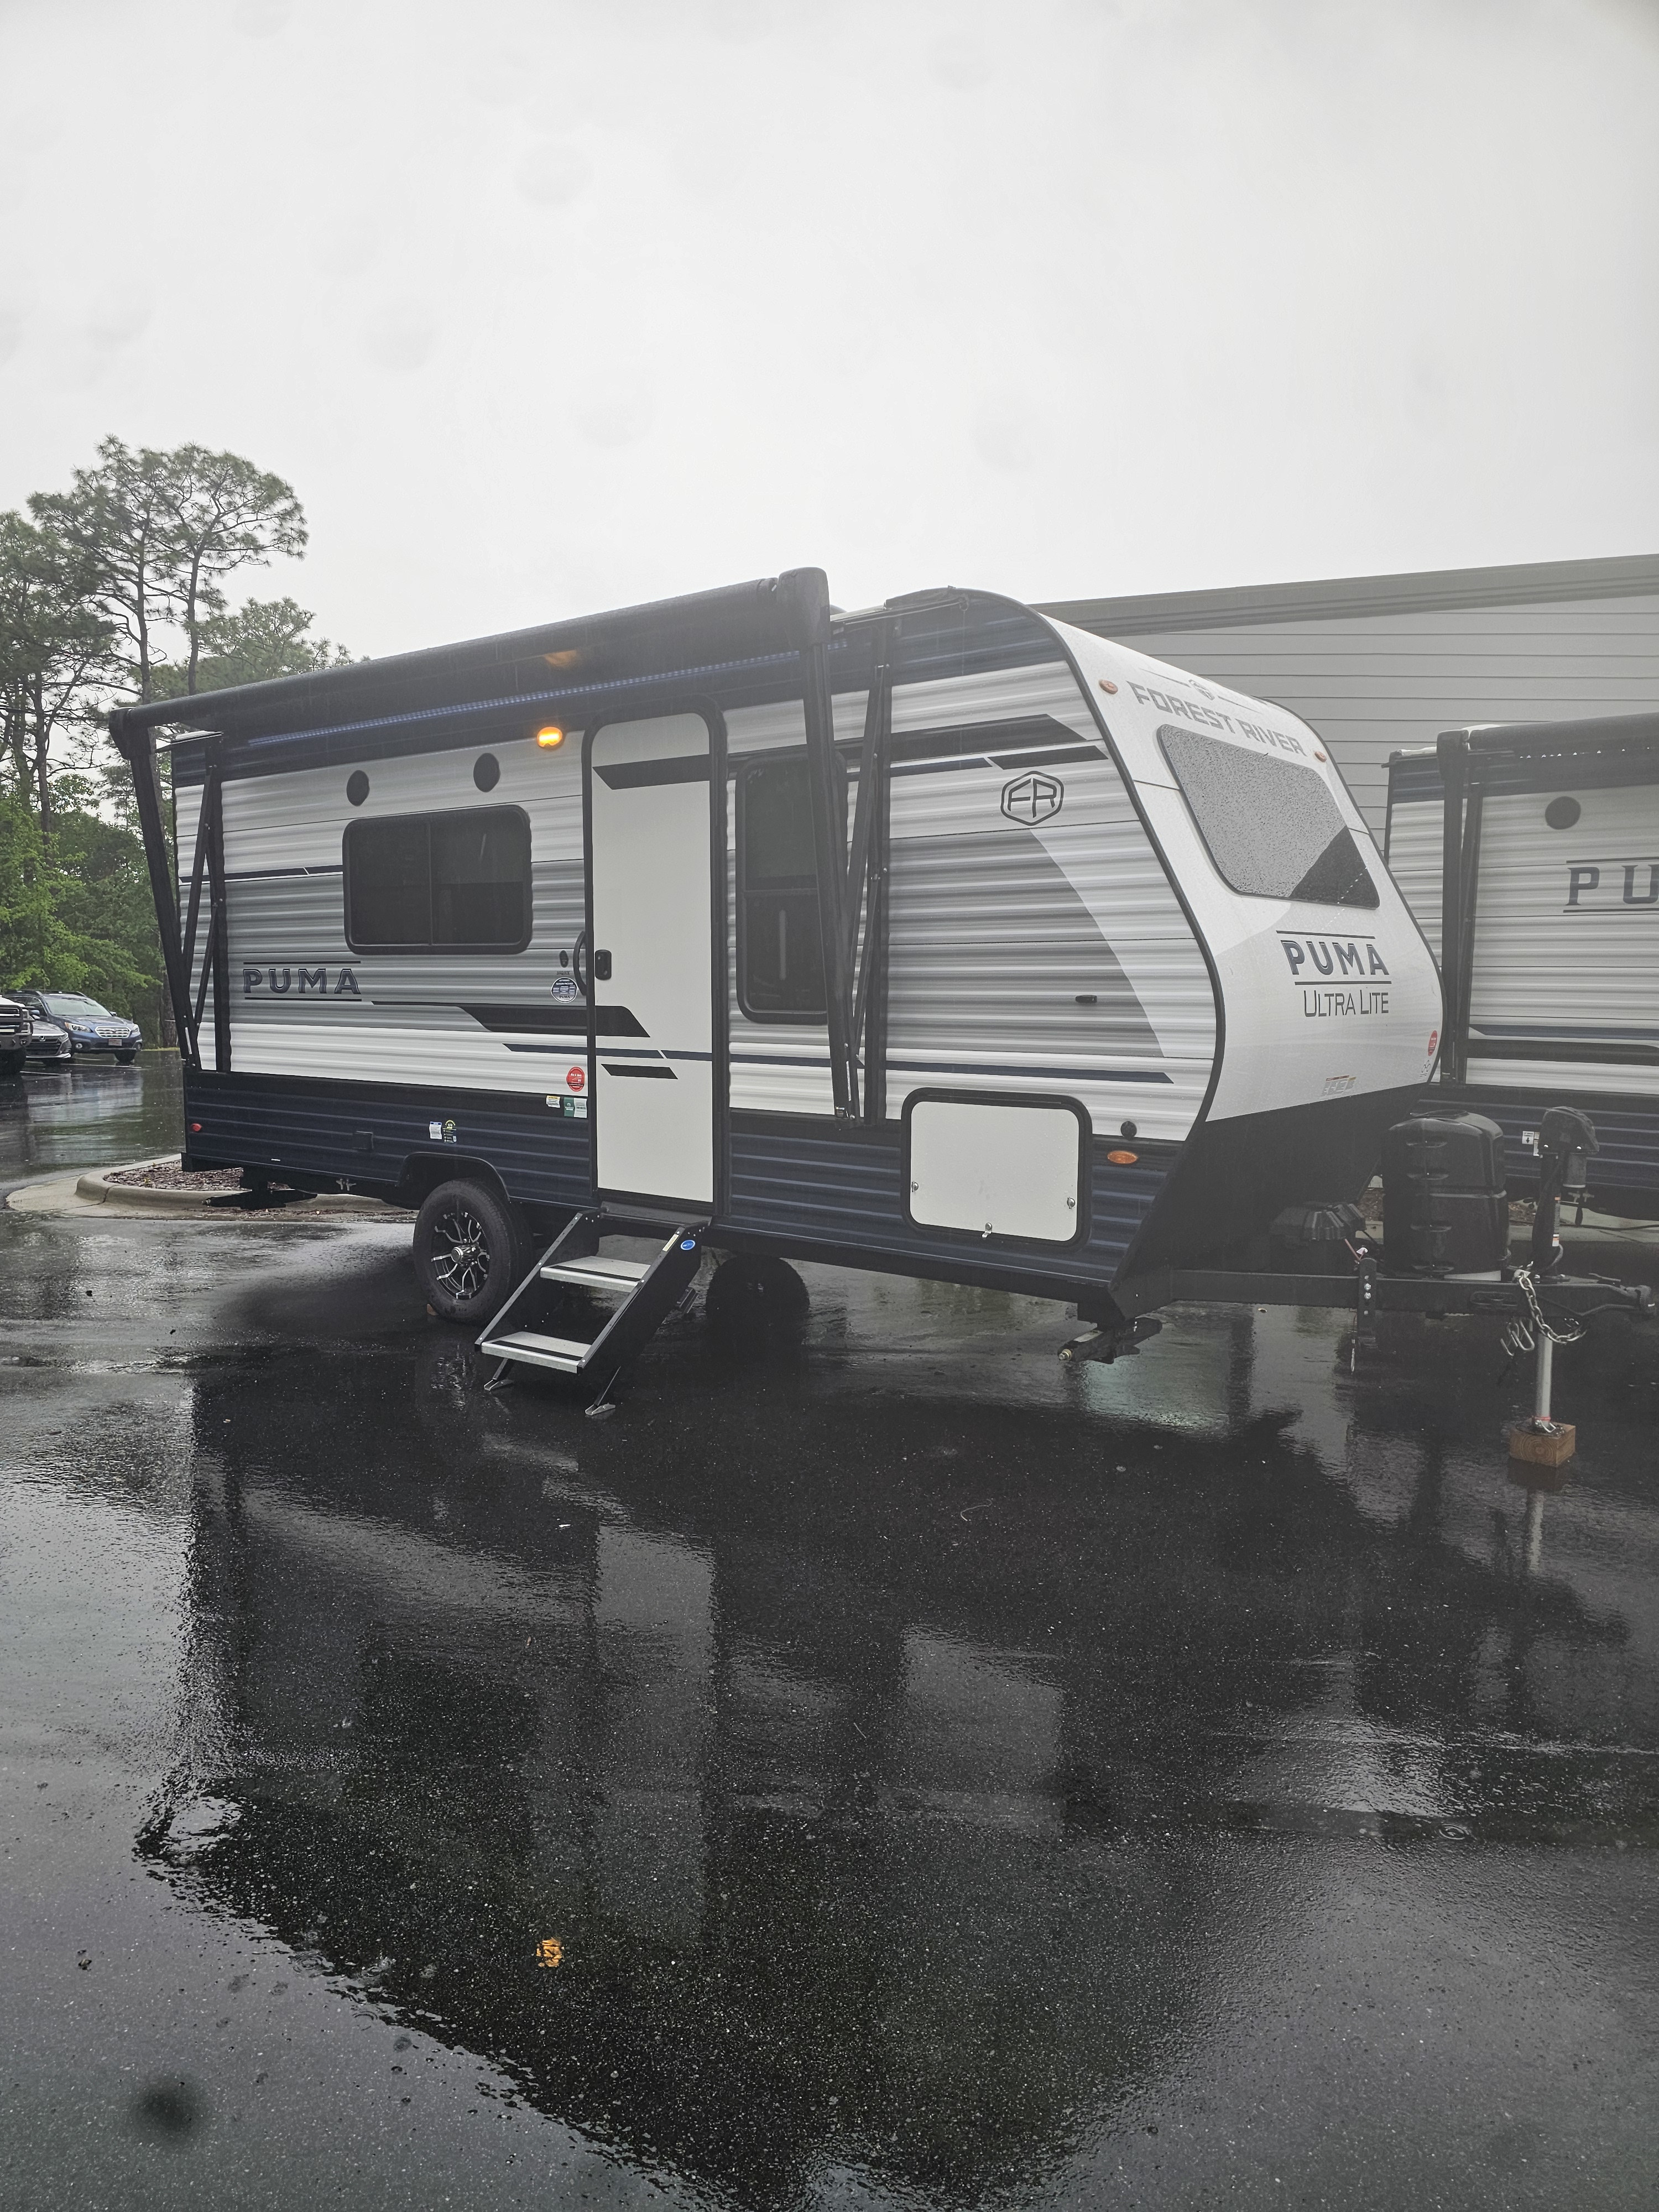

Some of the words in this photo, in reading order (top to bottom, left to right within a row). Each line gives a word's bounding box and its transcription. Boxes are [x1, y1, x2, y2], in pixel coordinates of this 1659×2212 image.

[1126, 681, 1235, 734] FOREST
[1235, 717, 1308, 757] RIVER
[1280, 938, 1390, 976] PUMA
[242, 968, 362, 995] PUMA
